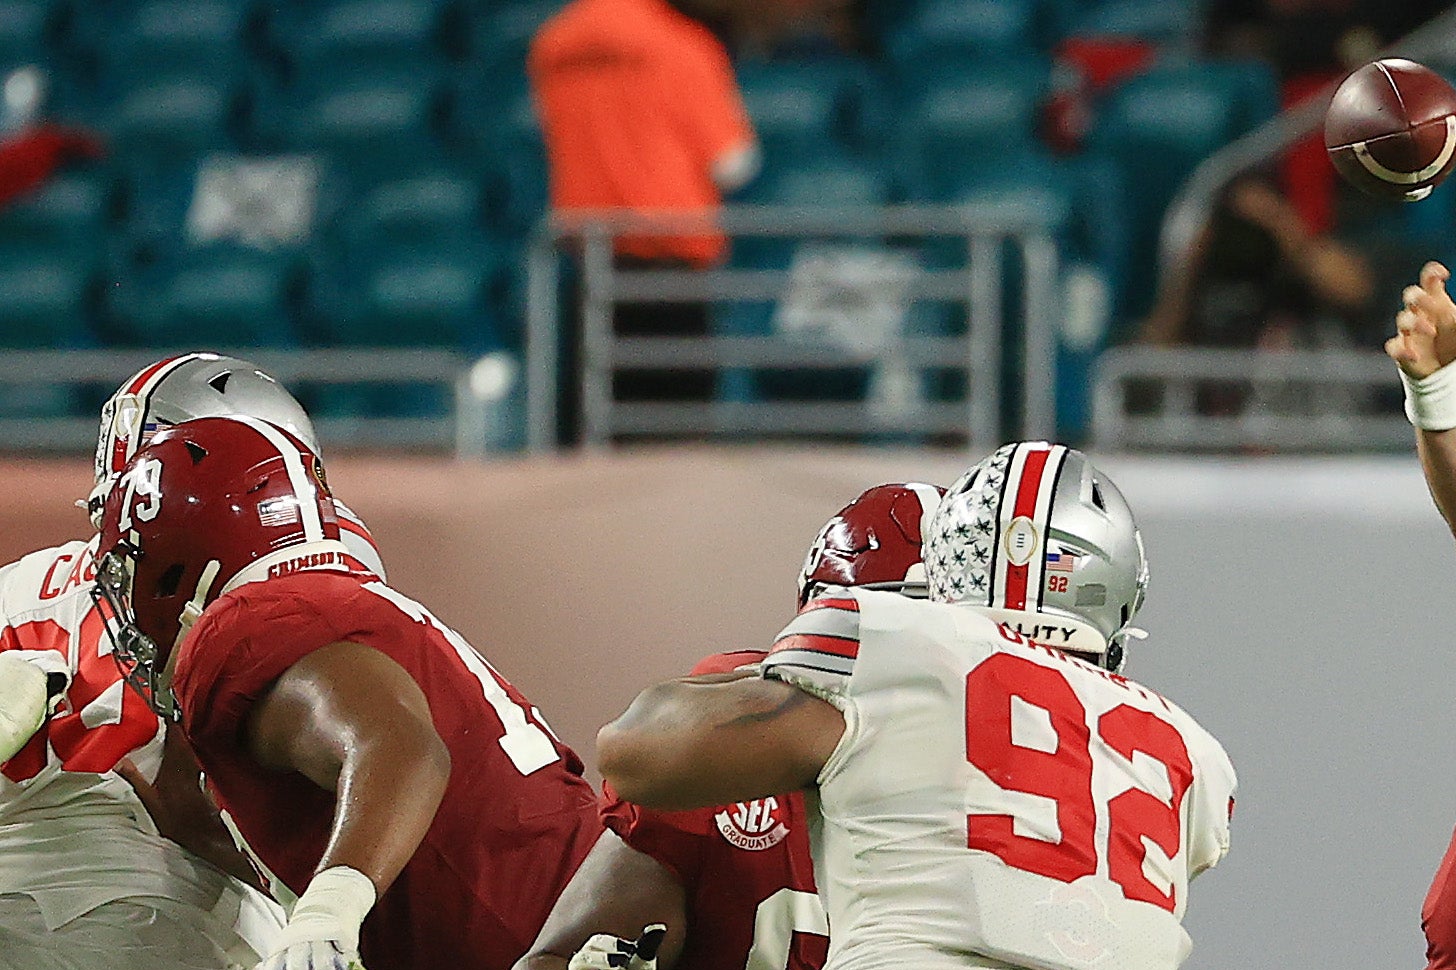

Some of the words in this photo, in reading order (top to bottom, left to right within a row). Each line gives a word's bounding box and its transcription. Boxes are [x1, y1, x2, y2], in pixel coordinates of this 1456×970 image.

[118, 458, 162, 533] 79
[1047, 575, 1068, 593] 92
[965, 651, 1194, 914] 92
[732, 796, 779, 833] SEC
[722, 824, 777, 849] GRADUATE
